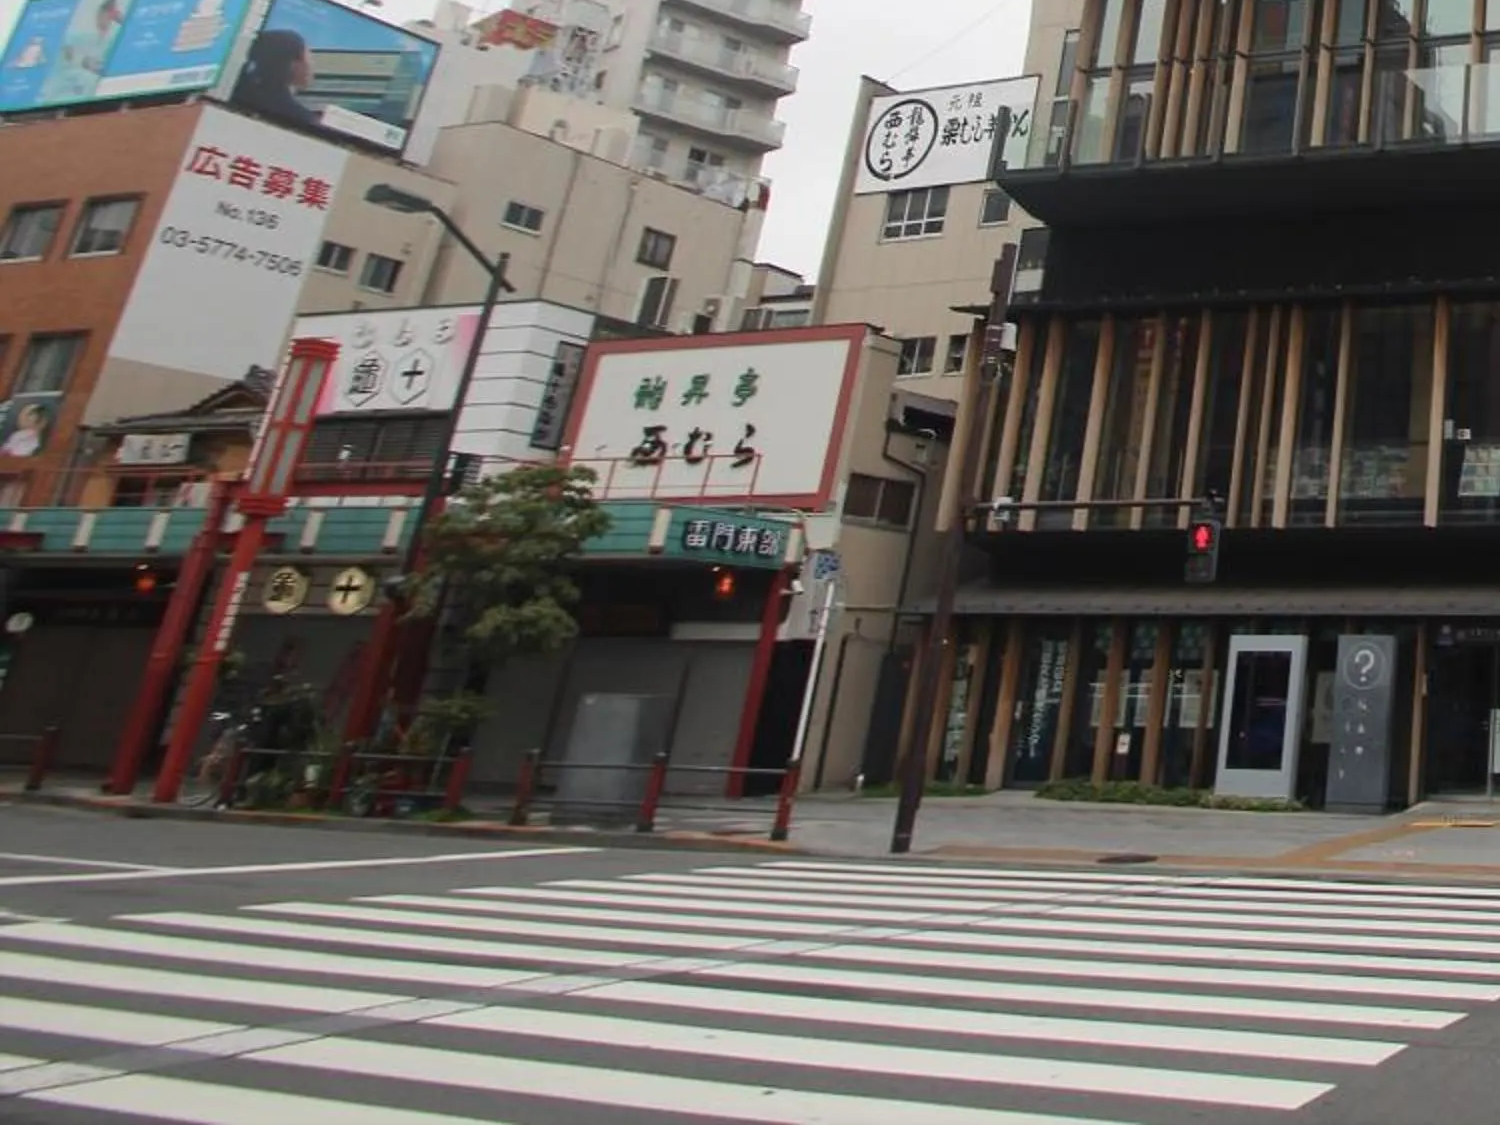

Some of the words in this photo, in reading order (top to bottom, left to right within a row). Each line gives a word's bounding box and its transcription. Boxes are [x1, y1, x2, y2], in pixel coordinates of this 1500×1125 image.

[185, 146, 333, 210] 広告募集
[686, 520, 781, 556] 雷門東部
